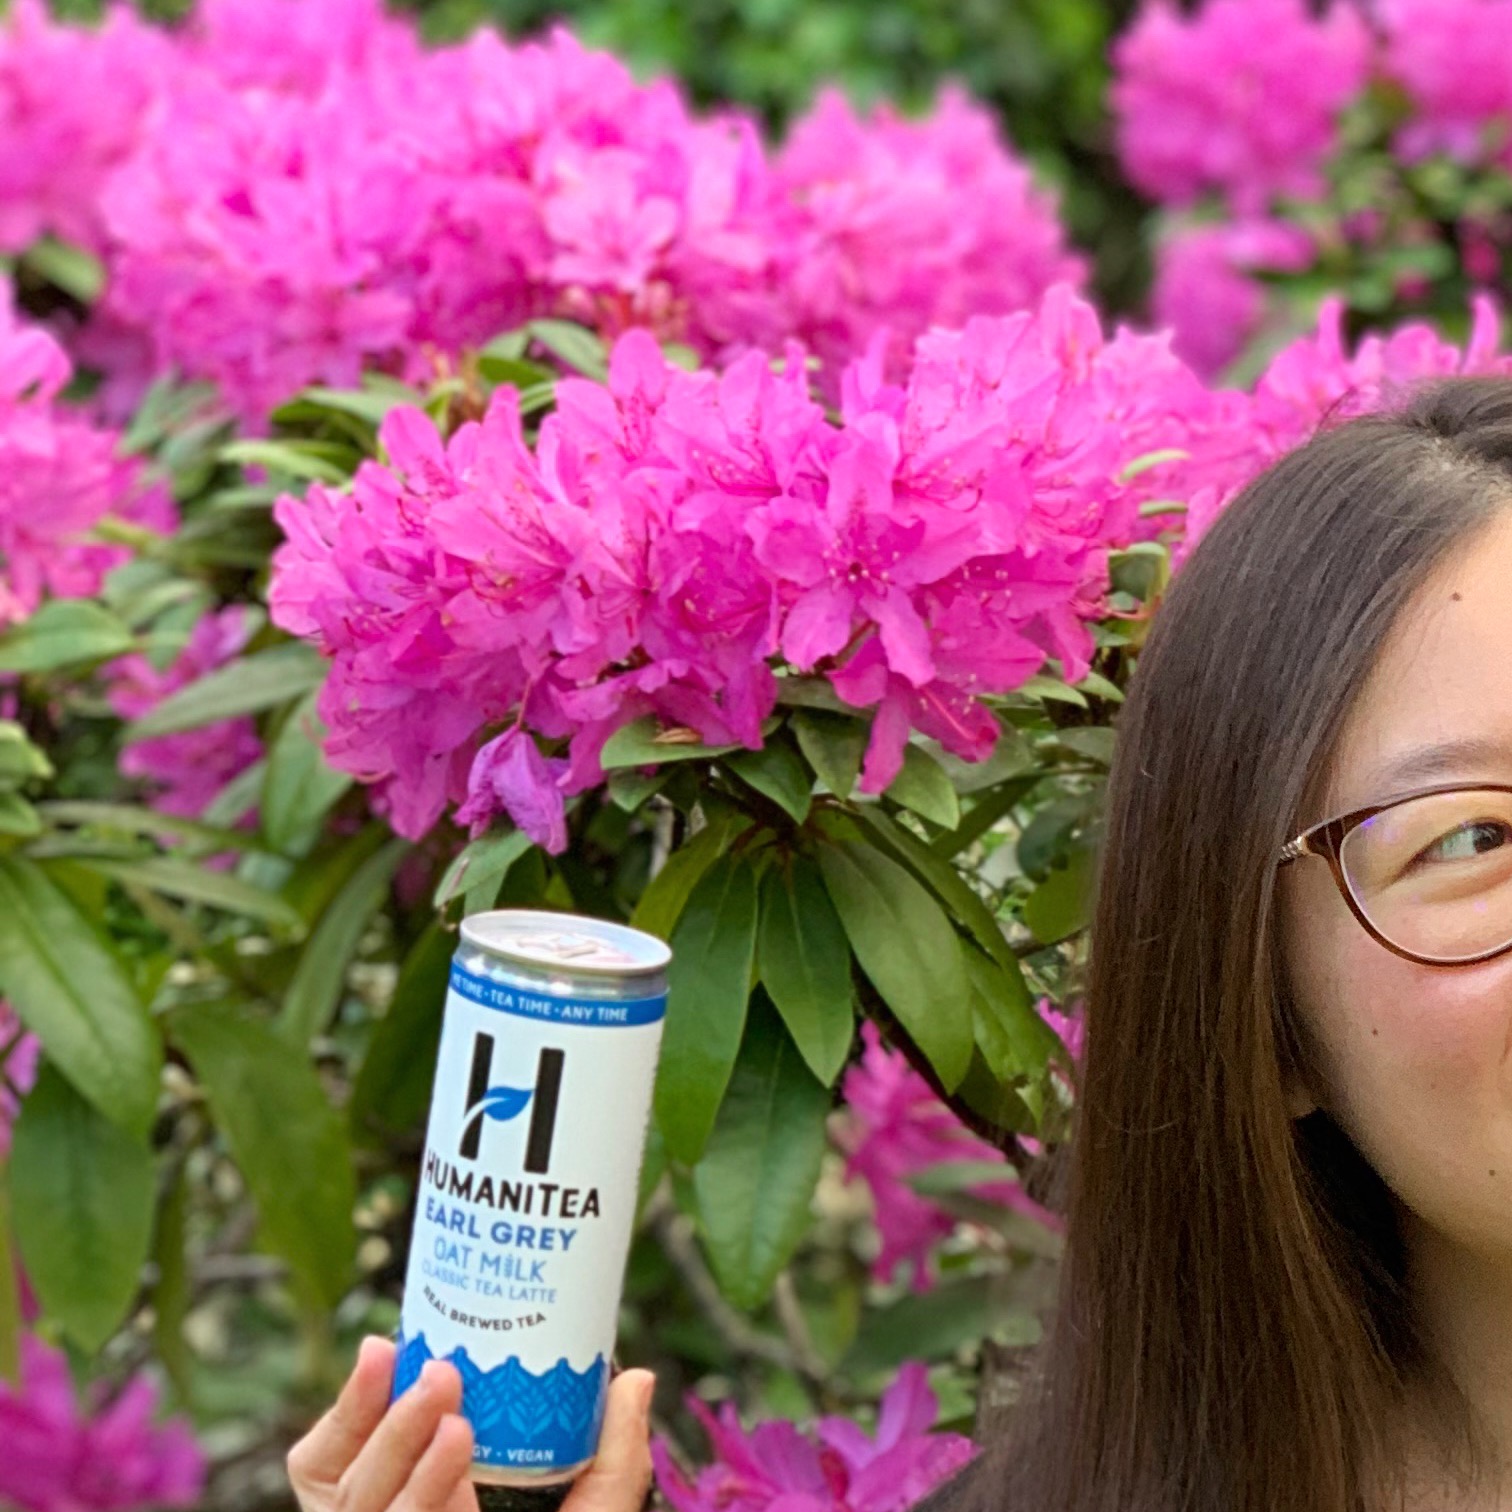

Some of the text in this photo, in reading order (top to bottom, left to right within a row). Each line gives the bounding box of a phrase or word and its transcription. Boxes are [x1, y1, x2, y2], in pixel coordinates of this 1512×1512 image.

[491, 989, 513, 1008] TEA
[519, 996, 552, 1016] TIME
[561, 1005, 593, 1021] ANY
[598, 1008, 628, 1022] TIME
[425, 1149, 600, 1218] HUMANITEA
[426, 1197, 577, 1251] EARL GREY
[434, 1235, 473, 1269] OAT
[421, 1258, 557, 1304] CLASSIC TEA LATTE
[423, 1283, 547, 1331] REAL BREWED TEA
[506, 1447, 555, 1463] VEGAN
